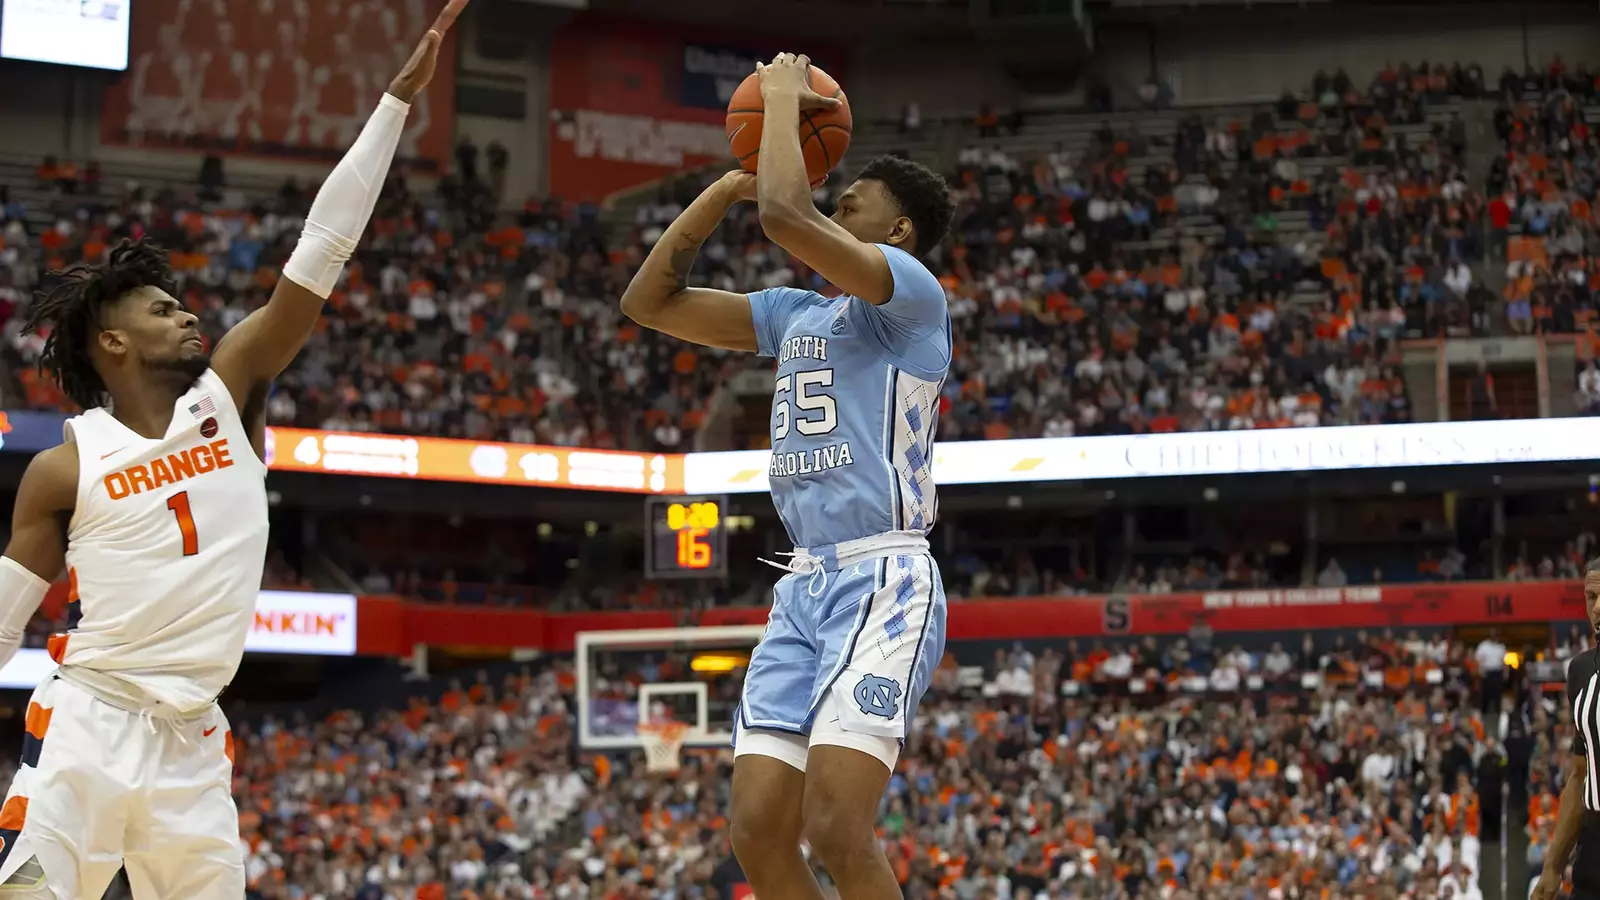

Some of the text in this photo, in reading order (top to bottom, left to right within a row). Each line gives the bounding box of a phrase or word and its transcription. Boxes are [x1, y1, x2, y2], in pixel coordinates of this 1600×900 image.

[775, 367, 839, 442] 55
[103, 438, 235, 501] ORANGE
[769, 441, 854, 477] AROLINA
[167, 490, 199, 557] 1
[676, 528, 712, 569] 16
